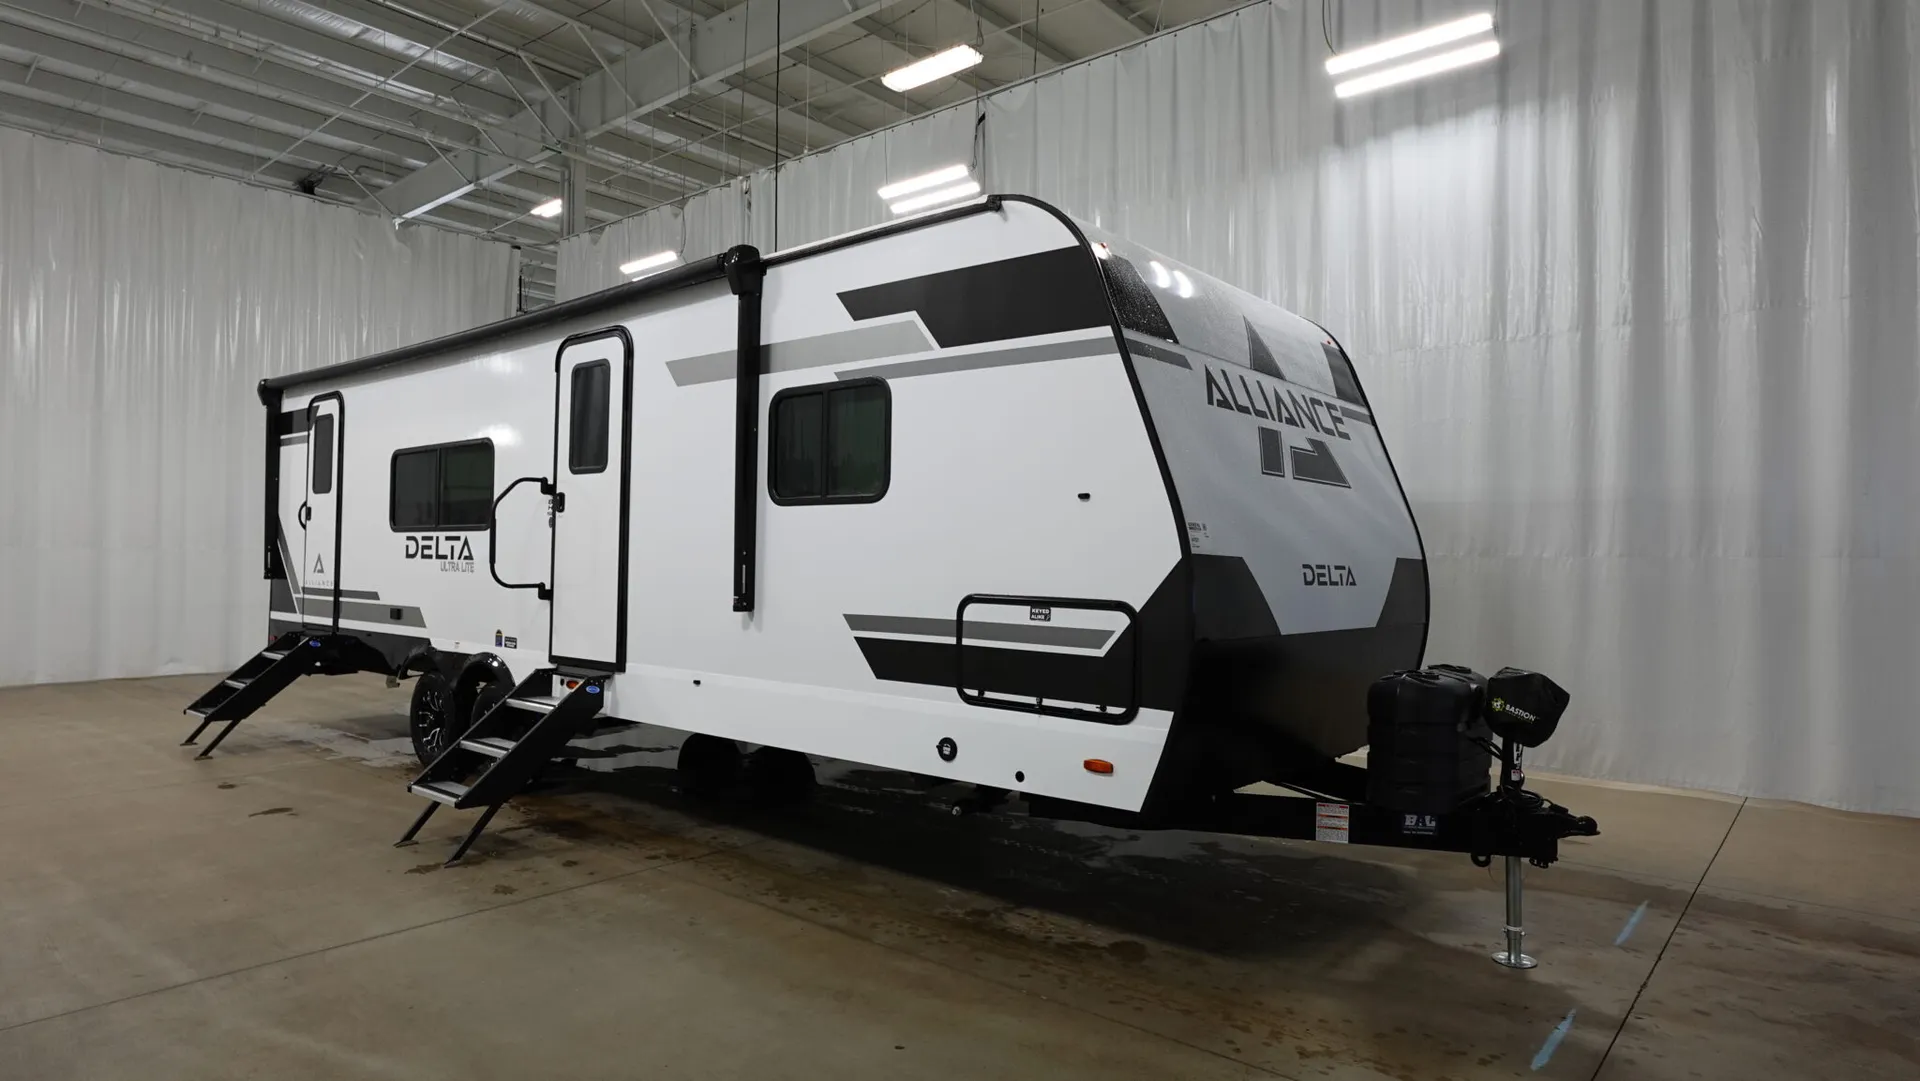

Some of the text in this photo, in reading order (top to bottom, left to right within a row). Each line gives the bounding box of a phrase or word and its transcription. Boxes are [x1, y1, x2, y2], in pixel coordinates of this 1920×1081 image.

[1204, 364, 1351, 441] ALLIANCE
[405, 535, 474, 560] DELTA
[440, 561, 475, 573] ULTRA LITE
[1302, 563, 1357, 586] DELTA
[1505, 704, 1536, 721] BASTION
